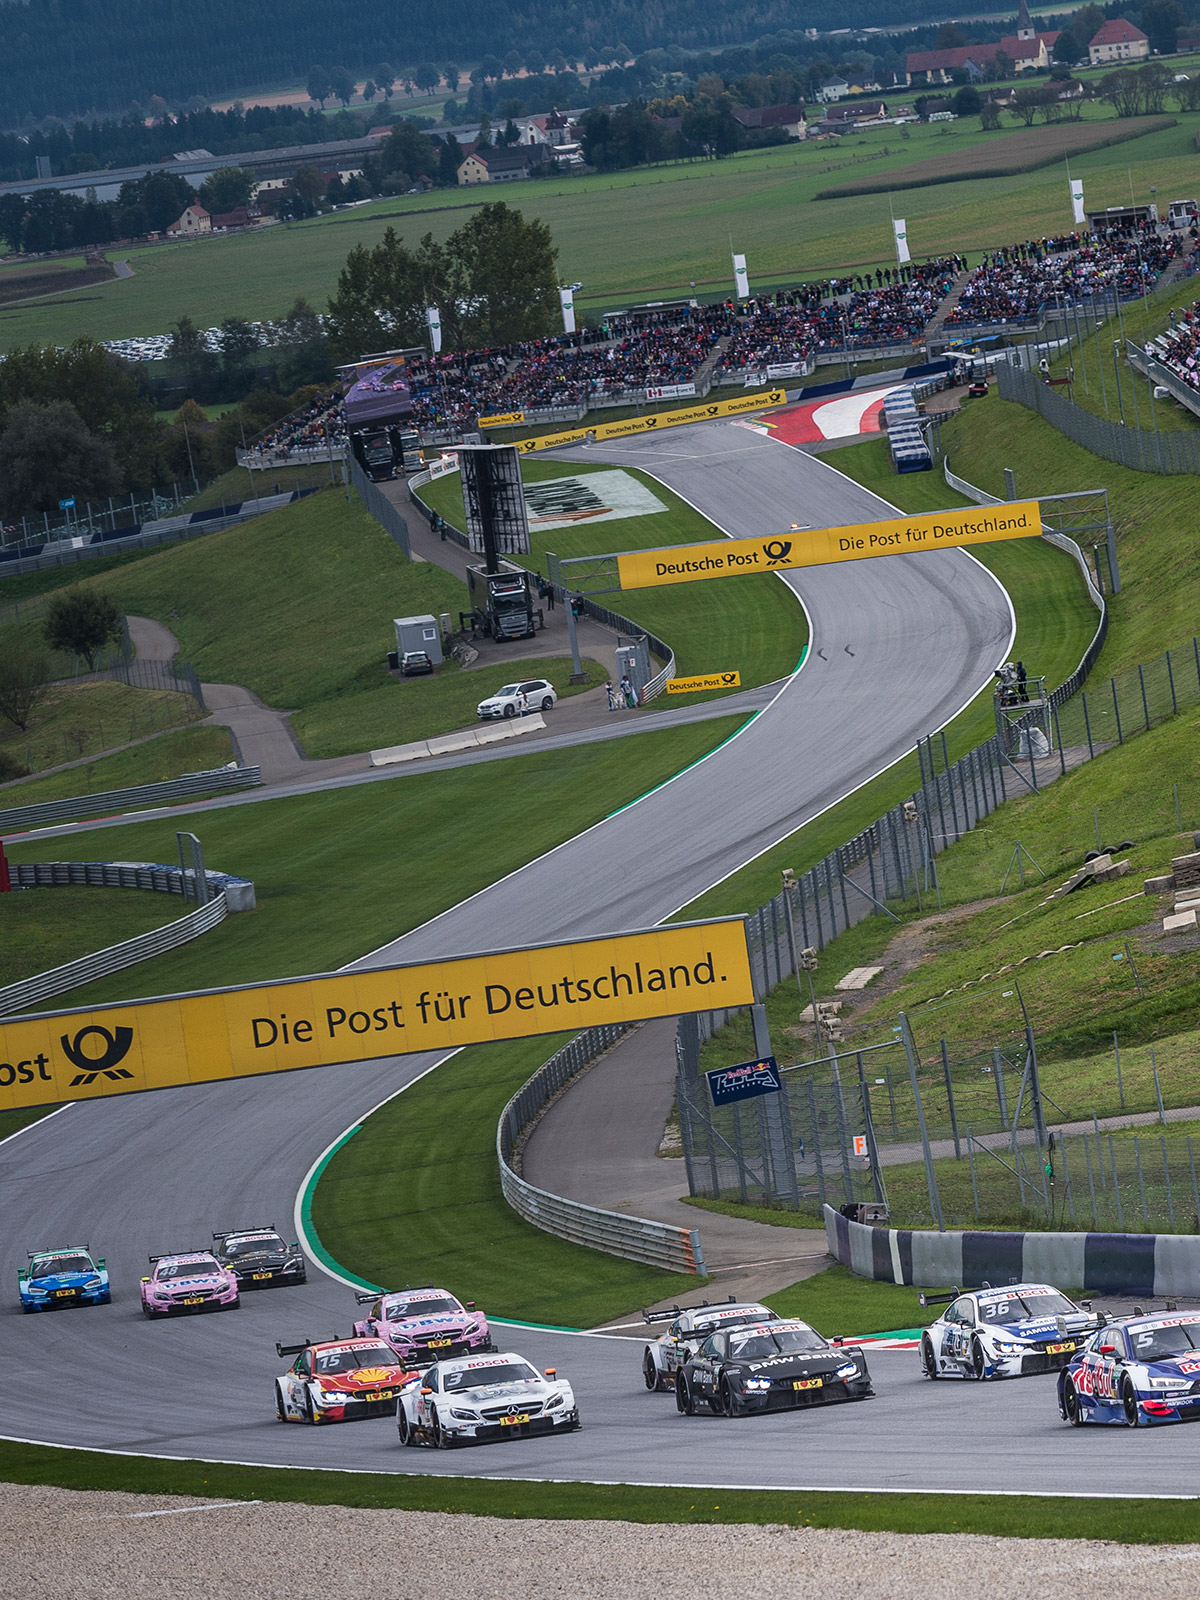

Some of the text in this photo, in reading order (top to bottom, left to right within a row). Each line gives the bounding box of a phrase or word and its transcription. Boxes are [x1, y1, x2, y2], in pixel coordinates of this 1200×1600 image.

[728, 398, 768, 411] Deutsche Post
[667, 414, 693, 423] Deutsche
[606, 426, 632, 435] Deutsche
[545, 437, 571, 446] Deutsche
[839, 514, 1032, 551] Die Post für Deutschland.
[656, 552, 759, 576] Deutsche Post
[669, 681, 702, 691] Deutsche
[252, 952, 727, 1048] Die Post für Deutschland.
[0, 1053, 52, 1087] ost
[855, 1137, 864, 1154] F
[226, 1244, 238, 1253] 6
[35, 1261, 52, 1271] 77
[159, 1267, 178, 1276] 48
[180, 1278, 219, 1286] BWT
[1006, 1290, 1048, 1299] BOSCH
[388, 1305, 408, 1317] 22
[720, 1309, 758, 1318] BOSCH
[986, 1302, 1010, 1318] 36
[419, 1317, 465, 1326] BWT
[756, 1325, 800, 1335] BOSCH
[1137, 1332, 1154, 1348] 5
[340, 1343, 379, 1352] BOSCH
[734, 1339, 749, 1354] 7
[320, 1355, 340, 1368] 15
[468, 1359, 509, 1368] BOSCH
[748, 1352, 843, 1372] BMW Bank
[447, 1373, 463, 1386] 3
